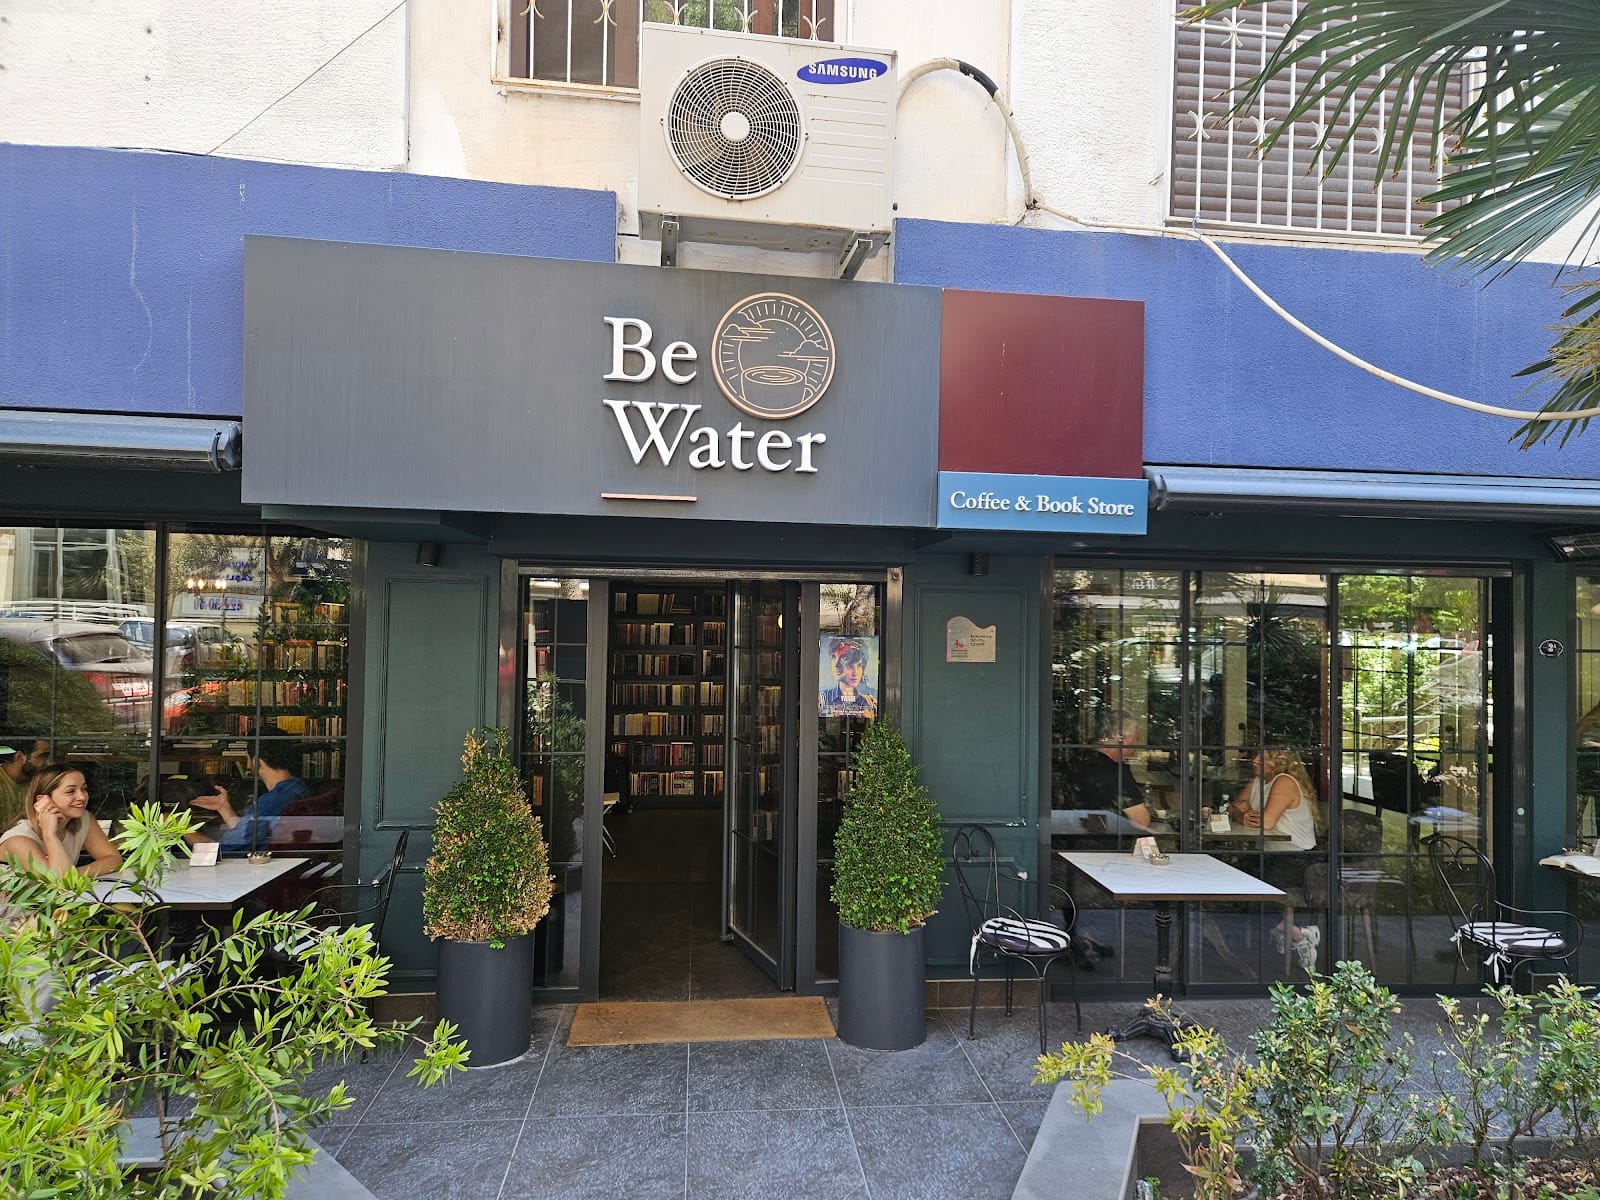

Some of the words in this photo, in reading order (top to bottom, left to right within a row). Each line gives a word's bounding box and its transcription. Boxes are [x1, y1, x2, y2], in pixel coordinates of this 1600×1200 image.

[808, 62, 877, 79] SAMSUNG
[603, 316, 698, 385] Be
[602, 398, 827, 474] Water
[950, 491, 1010, 511] Coffee
[1014, 495, 1032, 512] &
[1036, 494, 1084, 514] Book
[1087, 497, 1135, 516] Store
